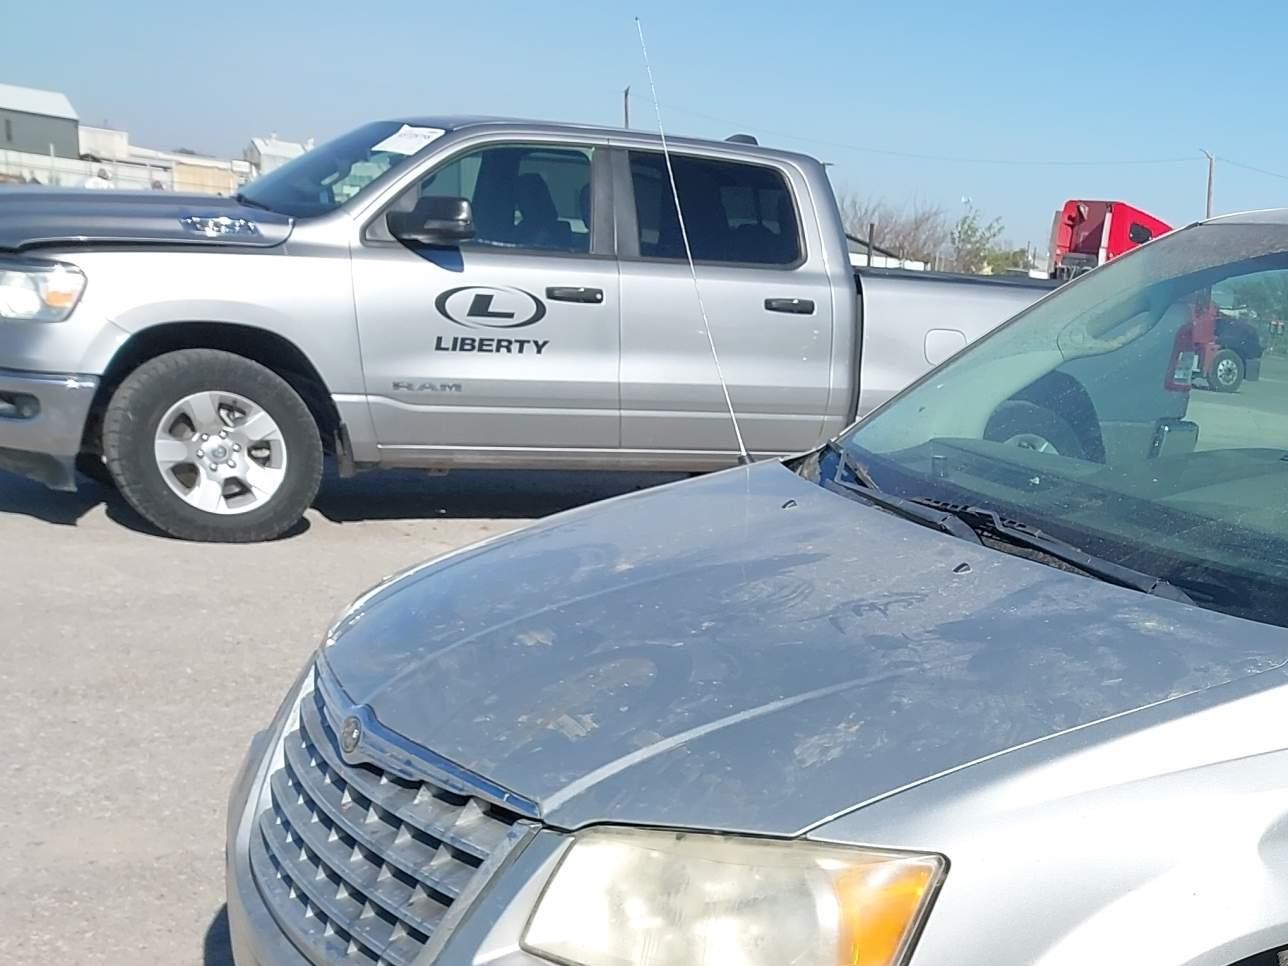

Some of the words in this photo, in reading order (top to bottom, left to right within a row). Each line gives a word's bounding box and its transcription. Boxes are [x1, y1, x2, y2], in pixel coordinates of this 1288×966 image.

[466, 293, 515, 319] L
[434, 335, 550, 355] LIBERTY
[391, 381, 463, 392] RAM
